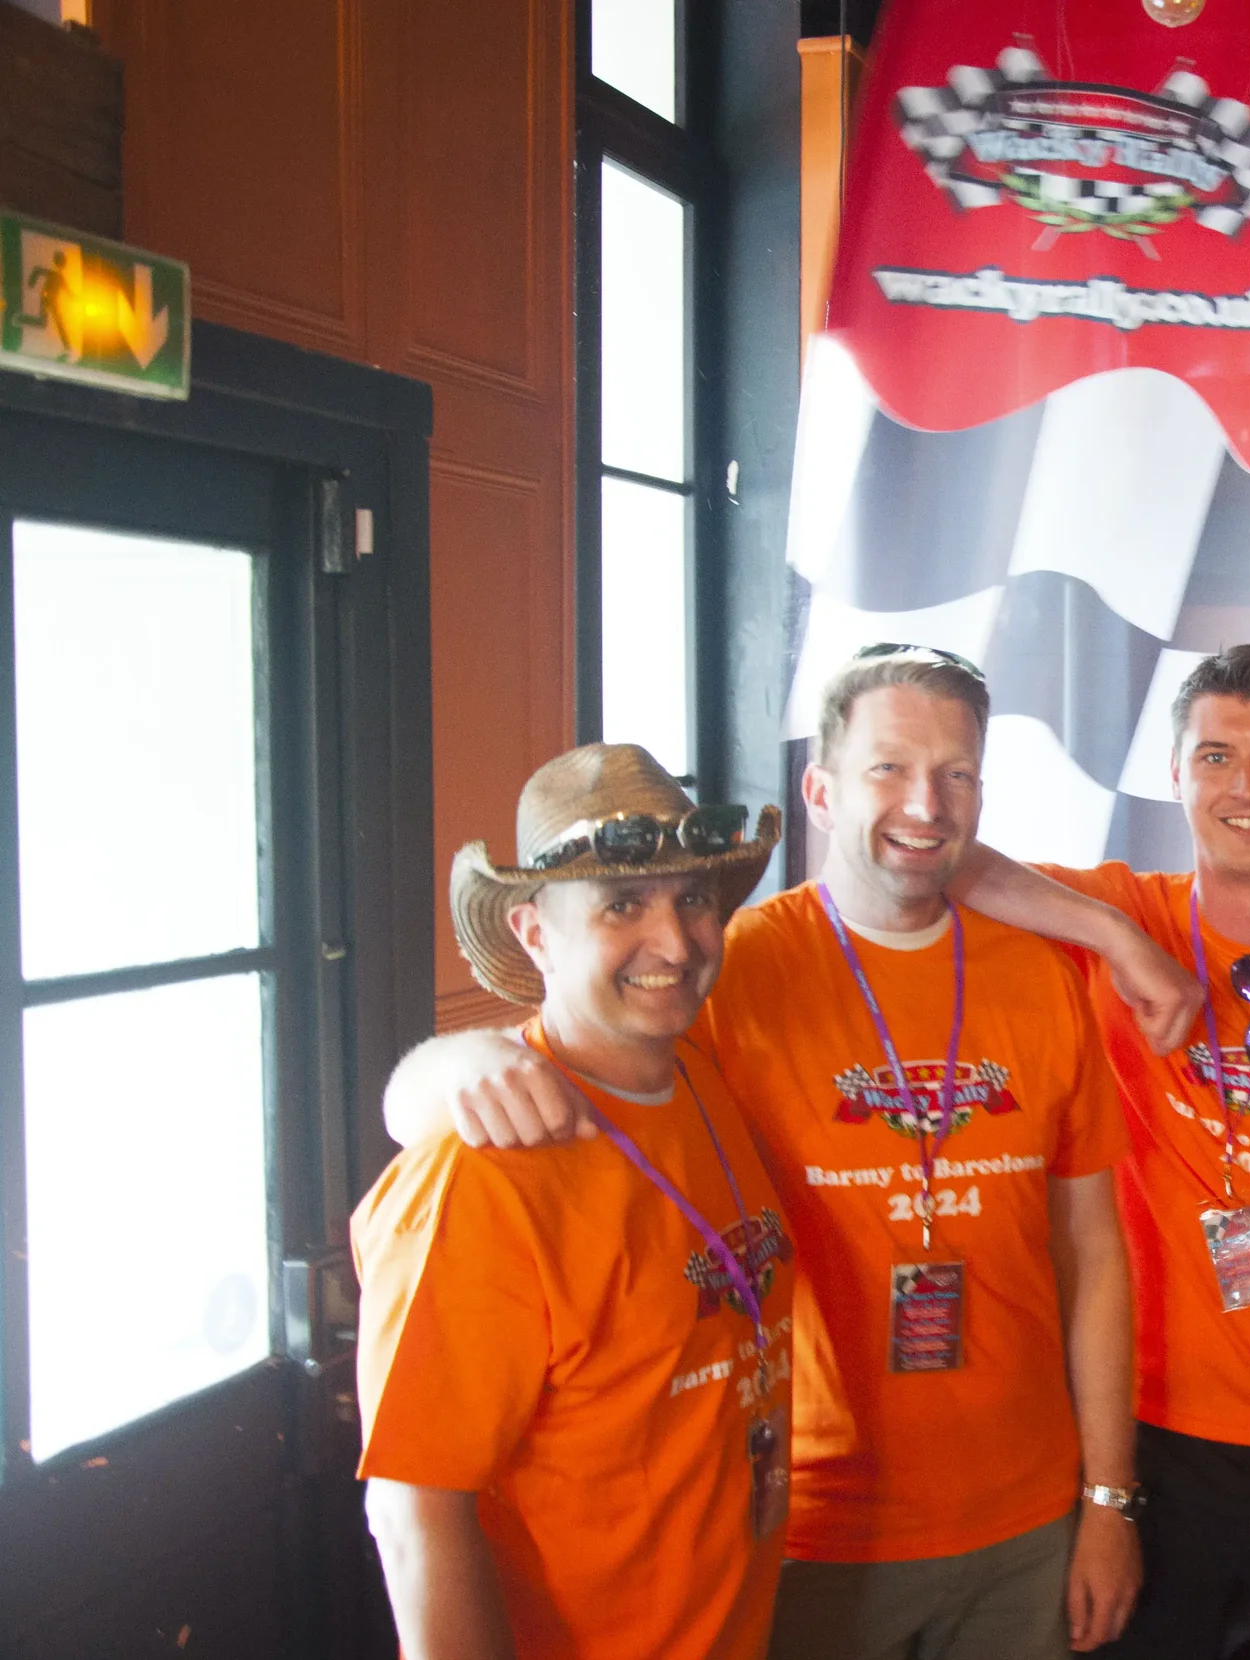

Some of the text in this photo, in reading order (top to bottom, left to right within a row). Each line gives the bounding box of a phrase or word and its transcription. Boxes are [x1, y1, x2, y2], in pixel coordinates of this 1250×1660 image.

[805, 1165, 893, 1187] Barmy
[933, 1153, 1045, 1179] Barcelona
[888, 1186, 982, 1221] 2024
